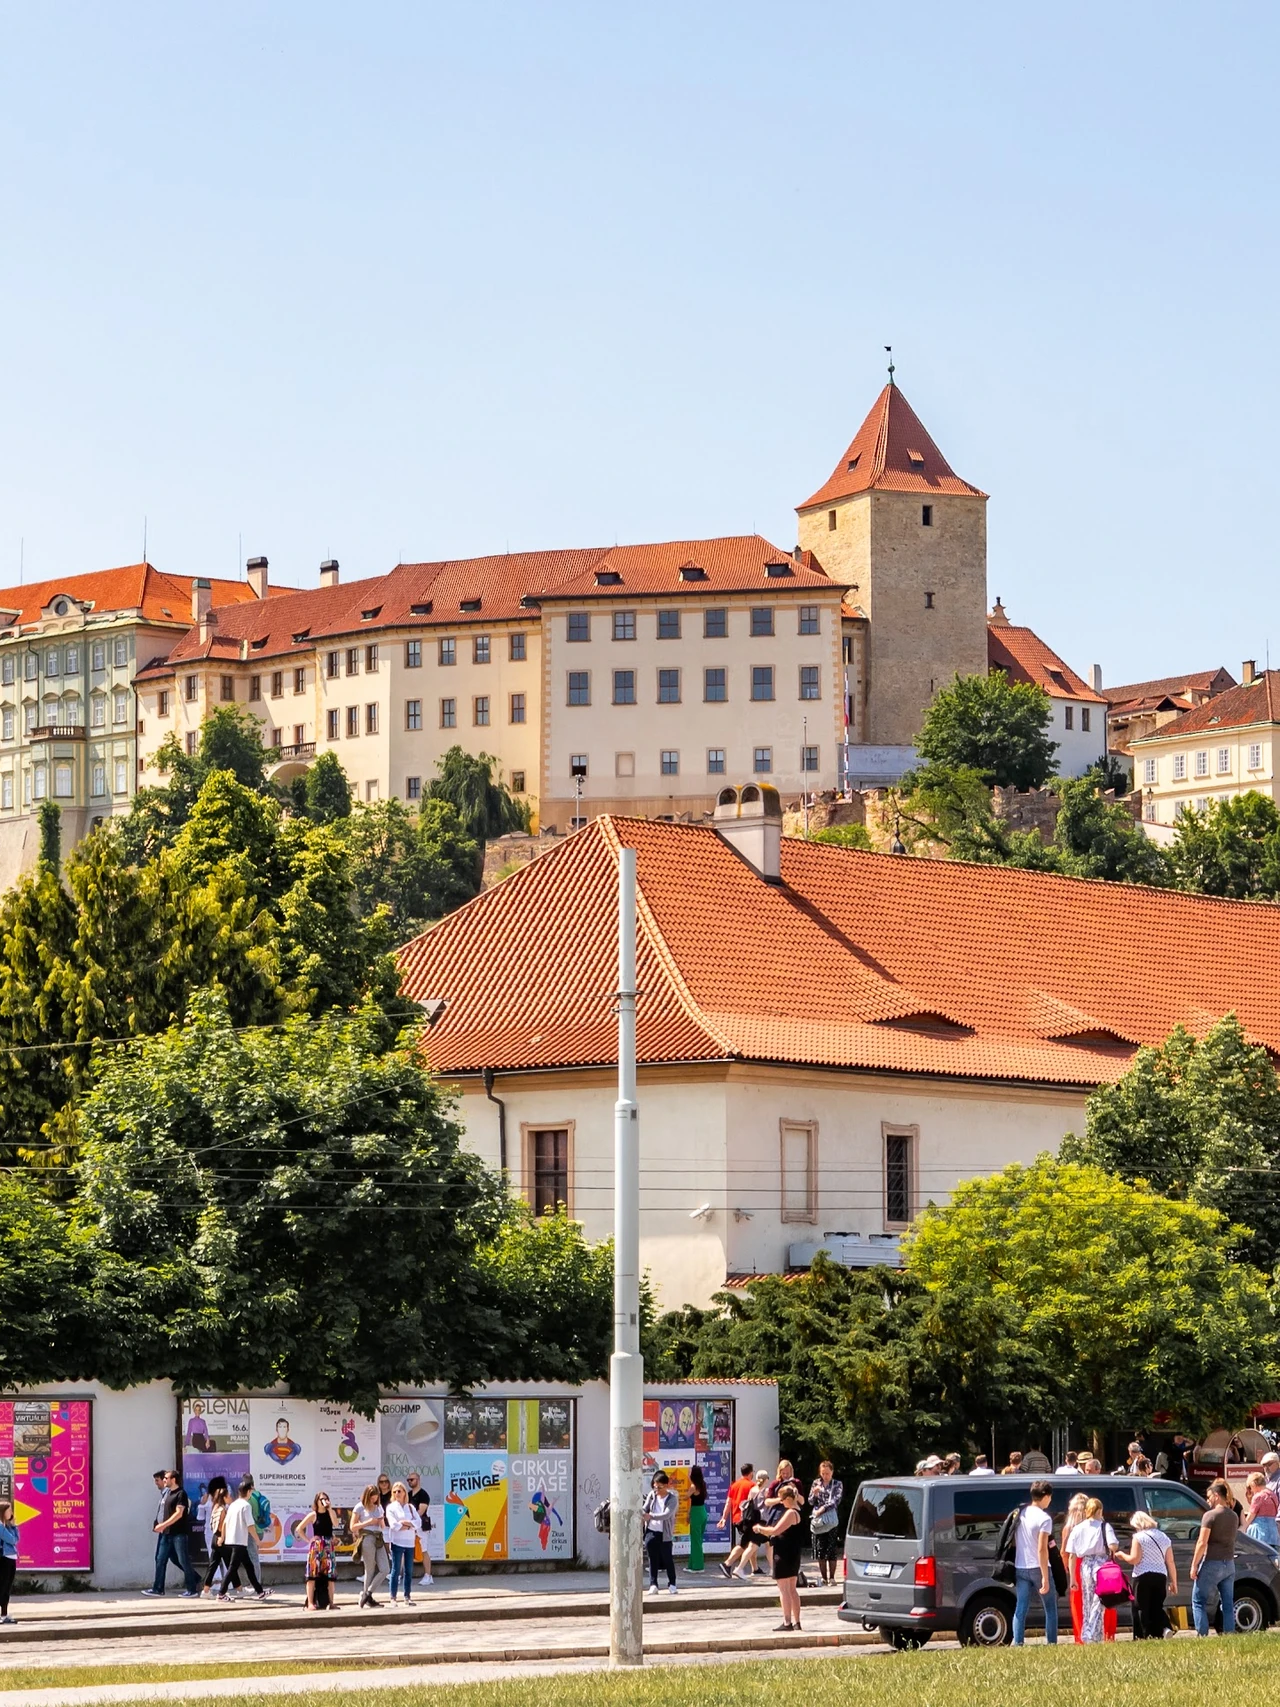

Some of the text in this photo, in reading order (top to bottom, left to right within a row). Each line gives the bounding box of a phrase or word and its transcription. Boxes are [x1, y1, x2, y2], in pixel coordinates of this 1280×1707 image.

[382, 1404, 421, 1414] G60HMP
[232, 1424, 249, 1432] 16.6.
[511, 1460, 567, 1476] CIRKUS
[52, 1472, 85, 1496] 23
[451, 1474, 500, 1492] FRINGE
[527, 1476, 568, 1492] BASE
